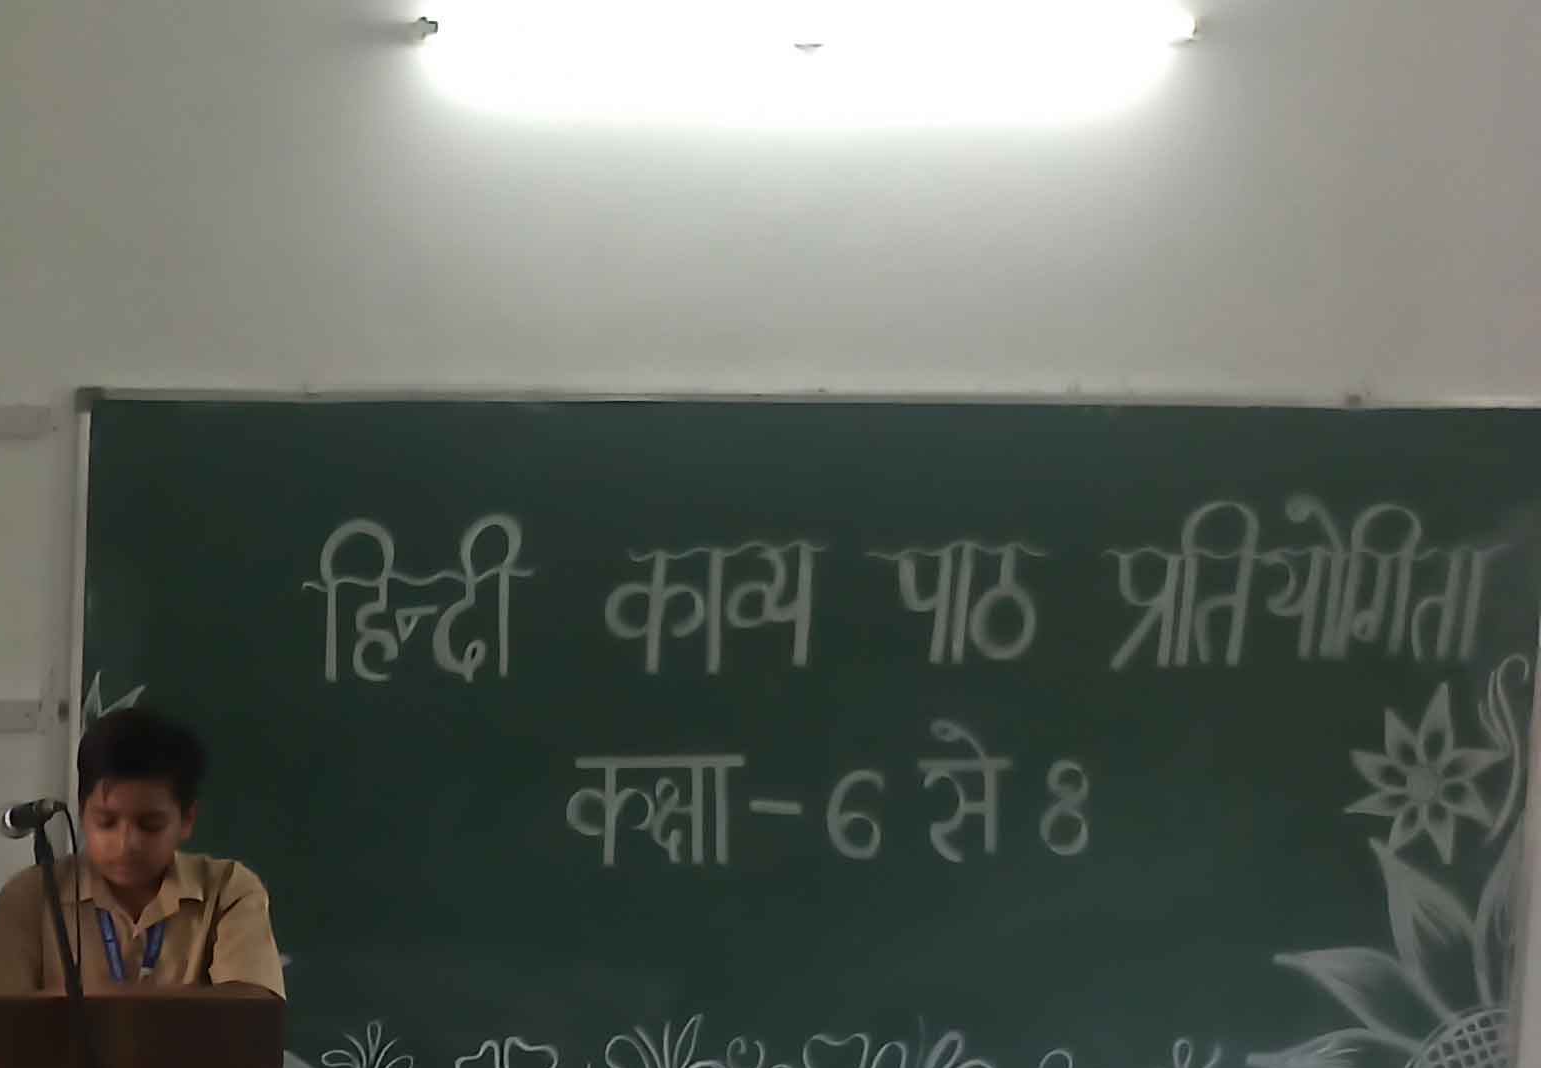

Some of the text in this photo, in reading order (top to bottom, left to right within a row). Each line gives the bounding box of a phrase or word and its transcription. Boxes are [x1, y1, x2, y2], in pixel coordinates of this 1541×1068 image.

[301, 493, 1511, 684] हिन्दी काव्य पाठ प्रतियोगिता
[917, 718, 1013, 863] से
[1039, 759, 1091, 857] 8
